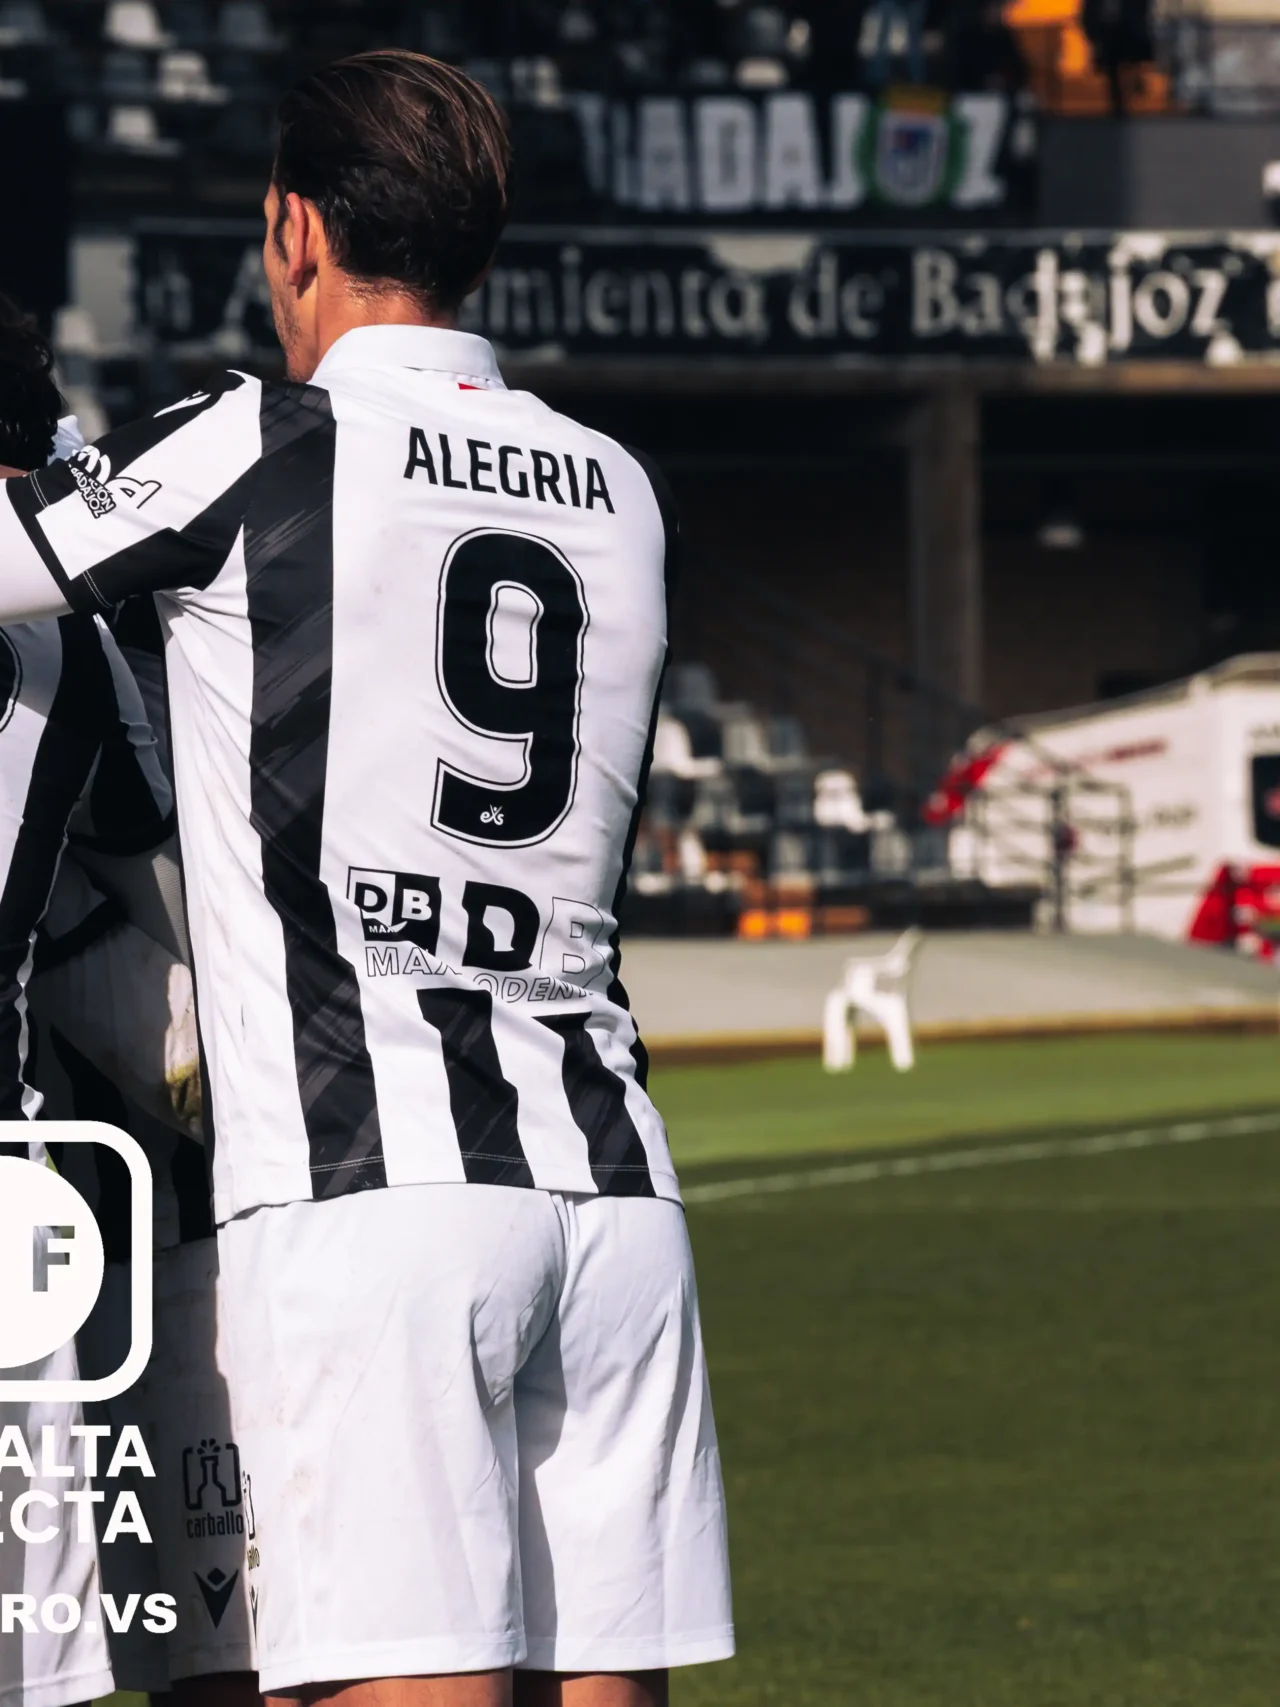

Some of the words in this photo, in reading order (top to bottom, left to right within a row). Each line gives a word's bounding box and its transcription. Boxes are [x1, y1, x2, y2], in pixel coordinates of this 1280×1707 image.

[787, 247, 885, 340] de
[403, 426, 616, 515] ALEGRIA
[431, 526, 590, 849] 9
[354, 881, 433, 921] DB
[462, 880, 606, 989] DB
[186, 1510, 245, 1539] carballo
